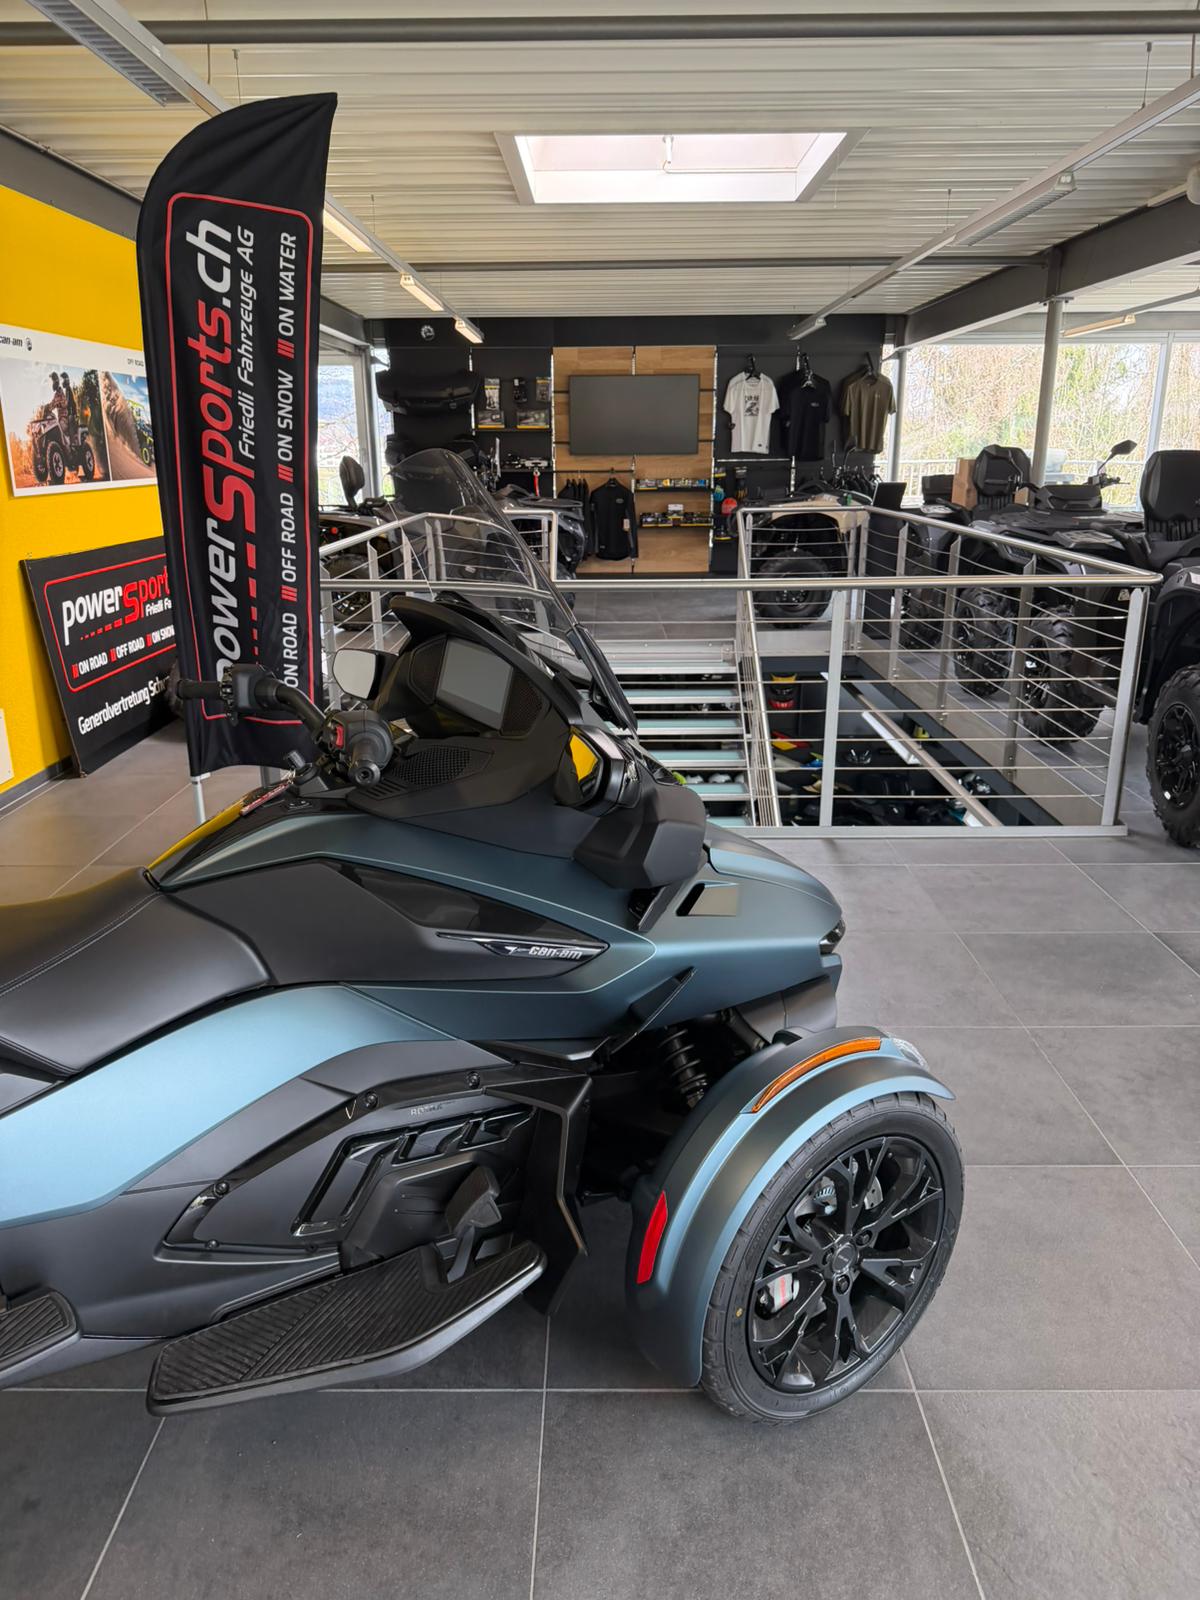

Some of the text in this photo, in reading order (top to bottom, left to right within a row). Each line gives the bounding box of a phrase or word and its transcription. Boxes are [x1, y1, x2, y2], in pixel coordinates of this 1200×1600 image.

[237, 225, 257, 460] Friedli Fahrzeuge AG
[277, 231, 299, 689] ON ROAD OFF ROAD ON SNOW ON WATER
[78, 658, 90, 675] ON
[89, 651, 108, 671] ROAD
[115, 645, 128, 659] OFF
[128, 637, 145, 654] ROAD
[151, 630, 161, 644] ON
[78, 686, 151, 735] Generalvertretung
